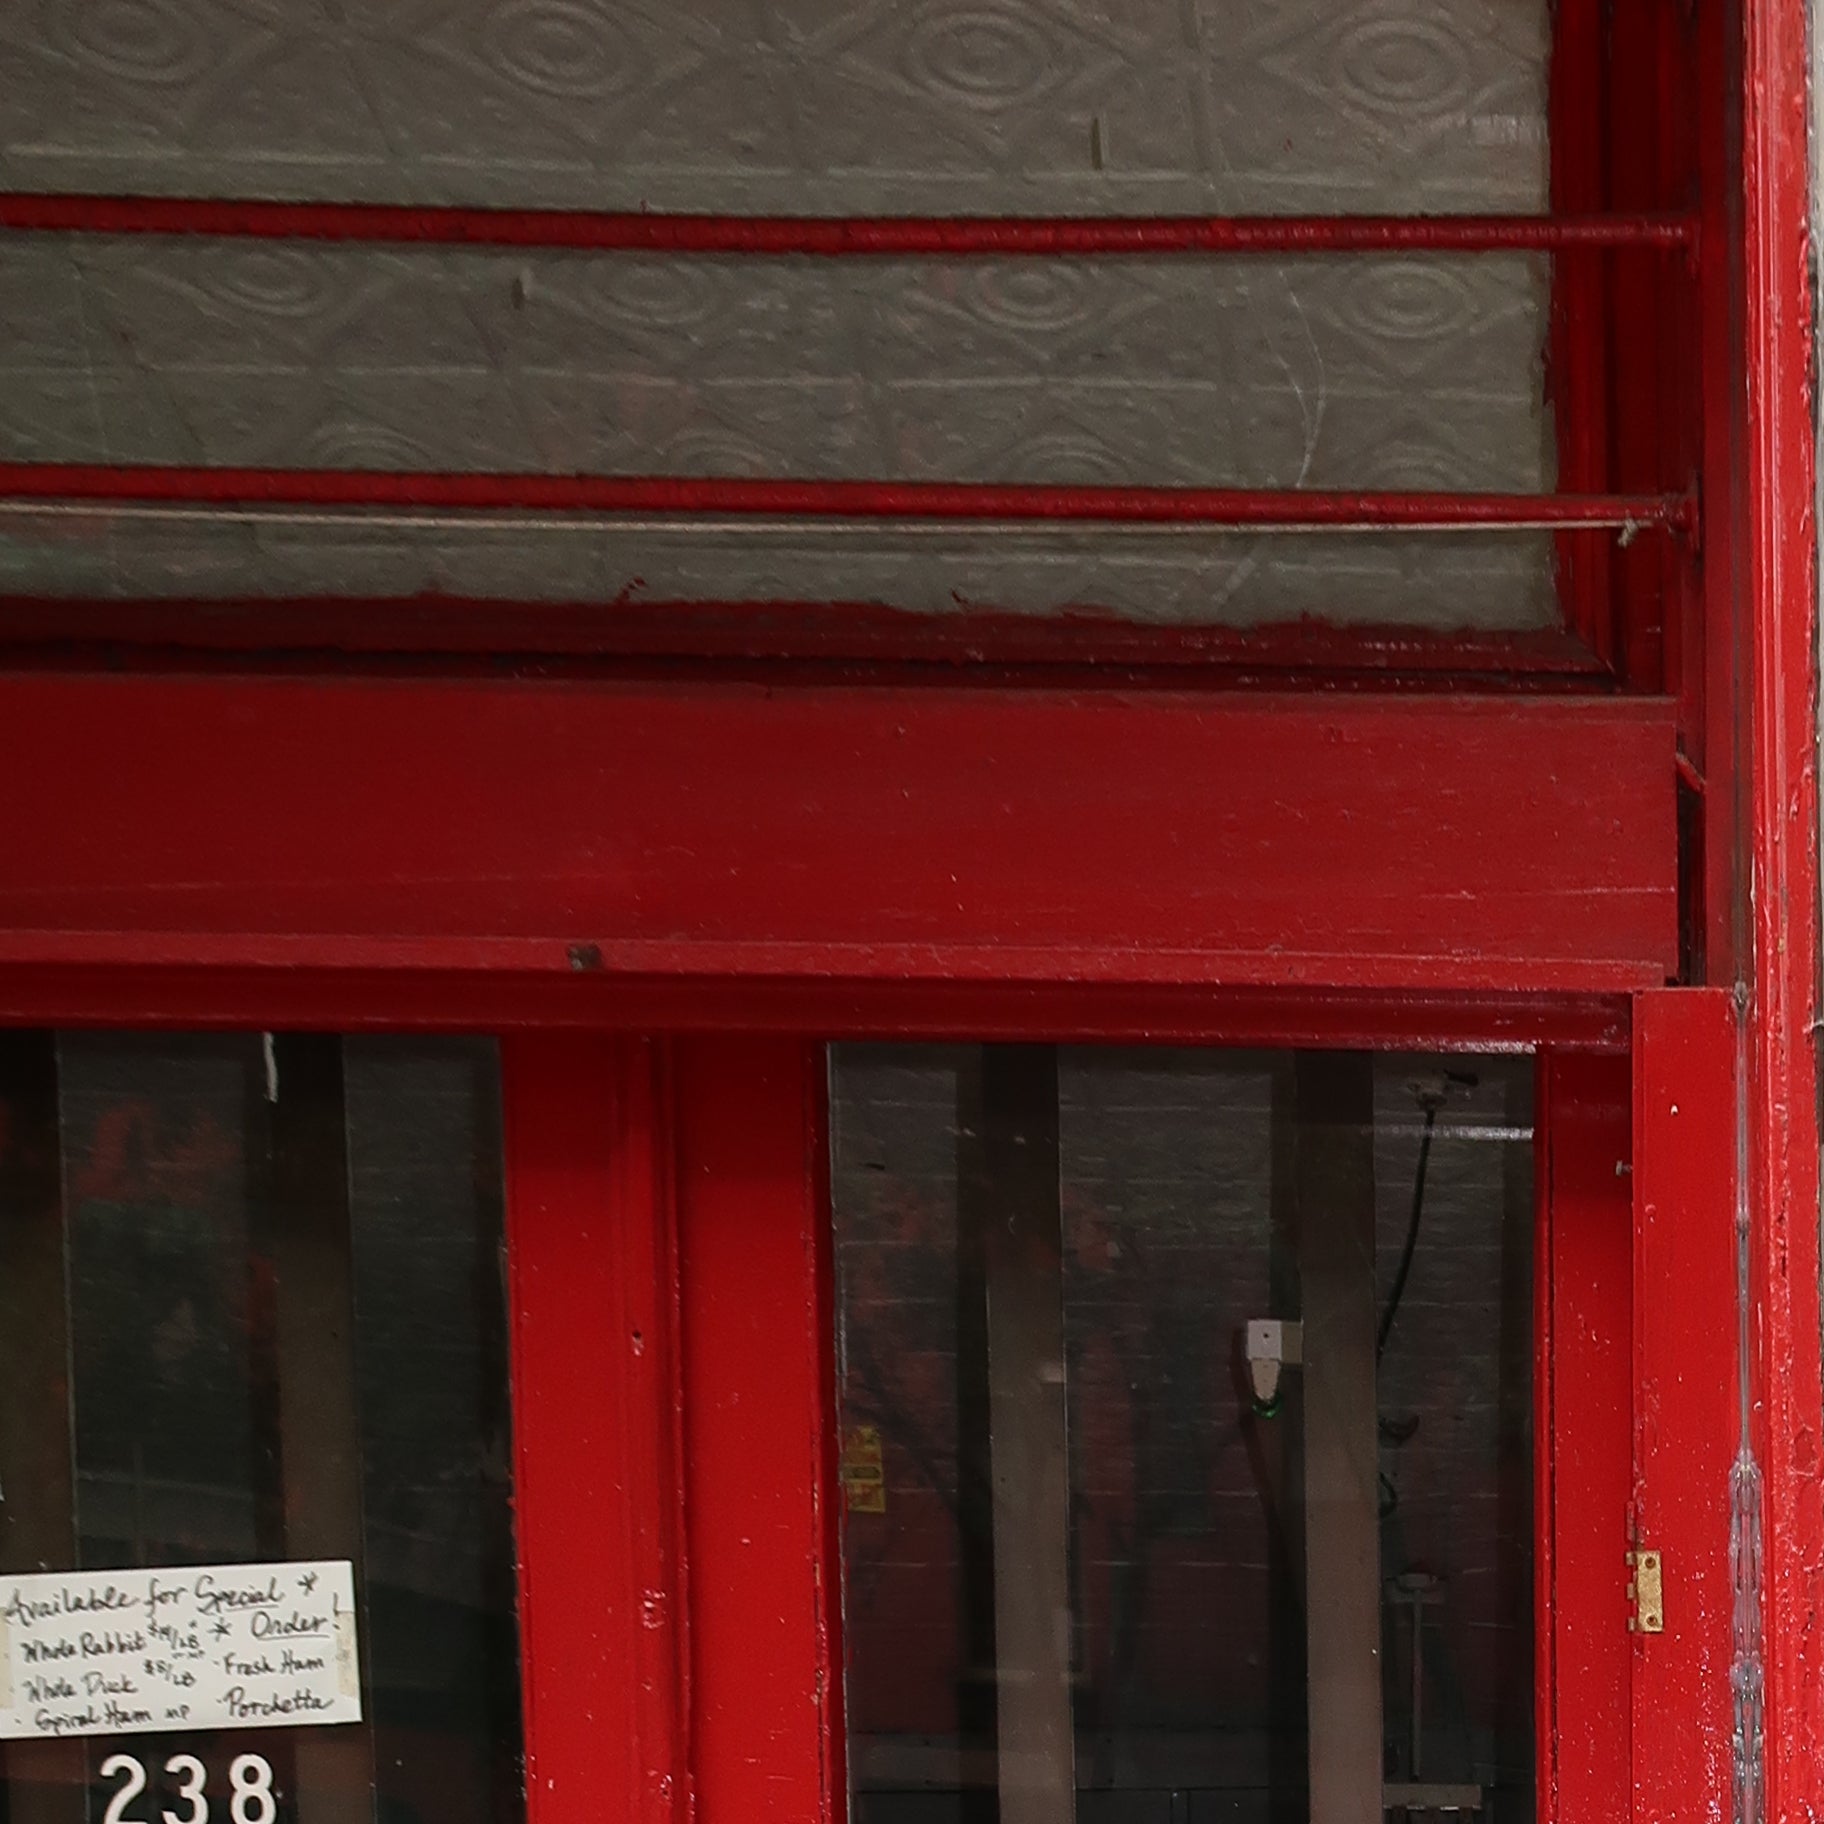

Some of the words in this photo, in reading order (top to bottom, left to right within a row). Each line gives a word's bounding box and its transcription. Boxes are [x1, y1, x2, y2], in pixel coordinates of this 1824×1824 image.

[4, 1586, 141, 1627] Available
[146, 1577, 188, 1618] for
[195, 1575, 286, 1616] Special
[21, 1638, 76, 1663] Whole
[79, 1632, 148, 1659] Rabbit
[223, 1652, 274, 1676] Fresh
[281, 1650, 325, 1676] Ham
[22, 1675, 76, 1702] Whole
[81, 1671, 138, 1697] Duck
[222, 1686, 336, 1717] Porchetta
[34, 1705, 100, 1735] Spiral
[104, 1700, 152, 1730] Ham
